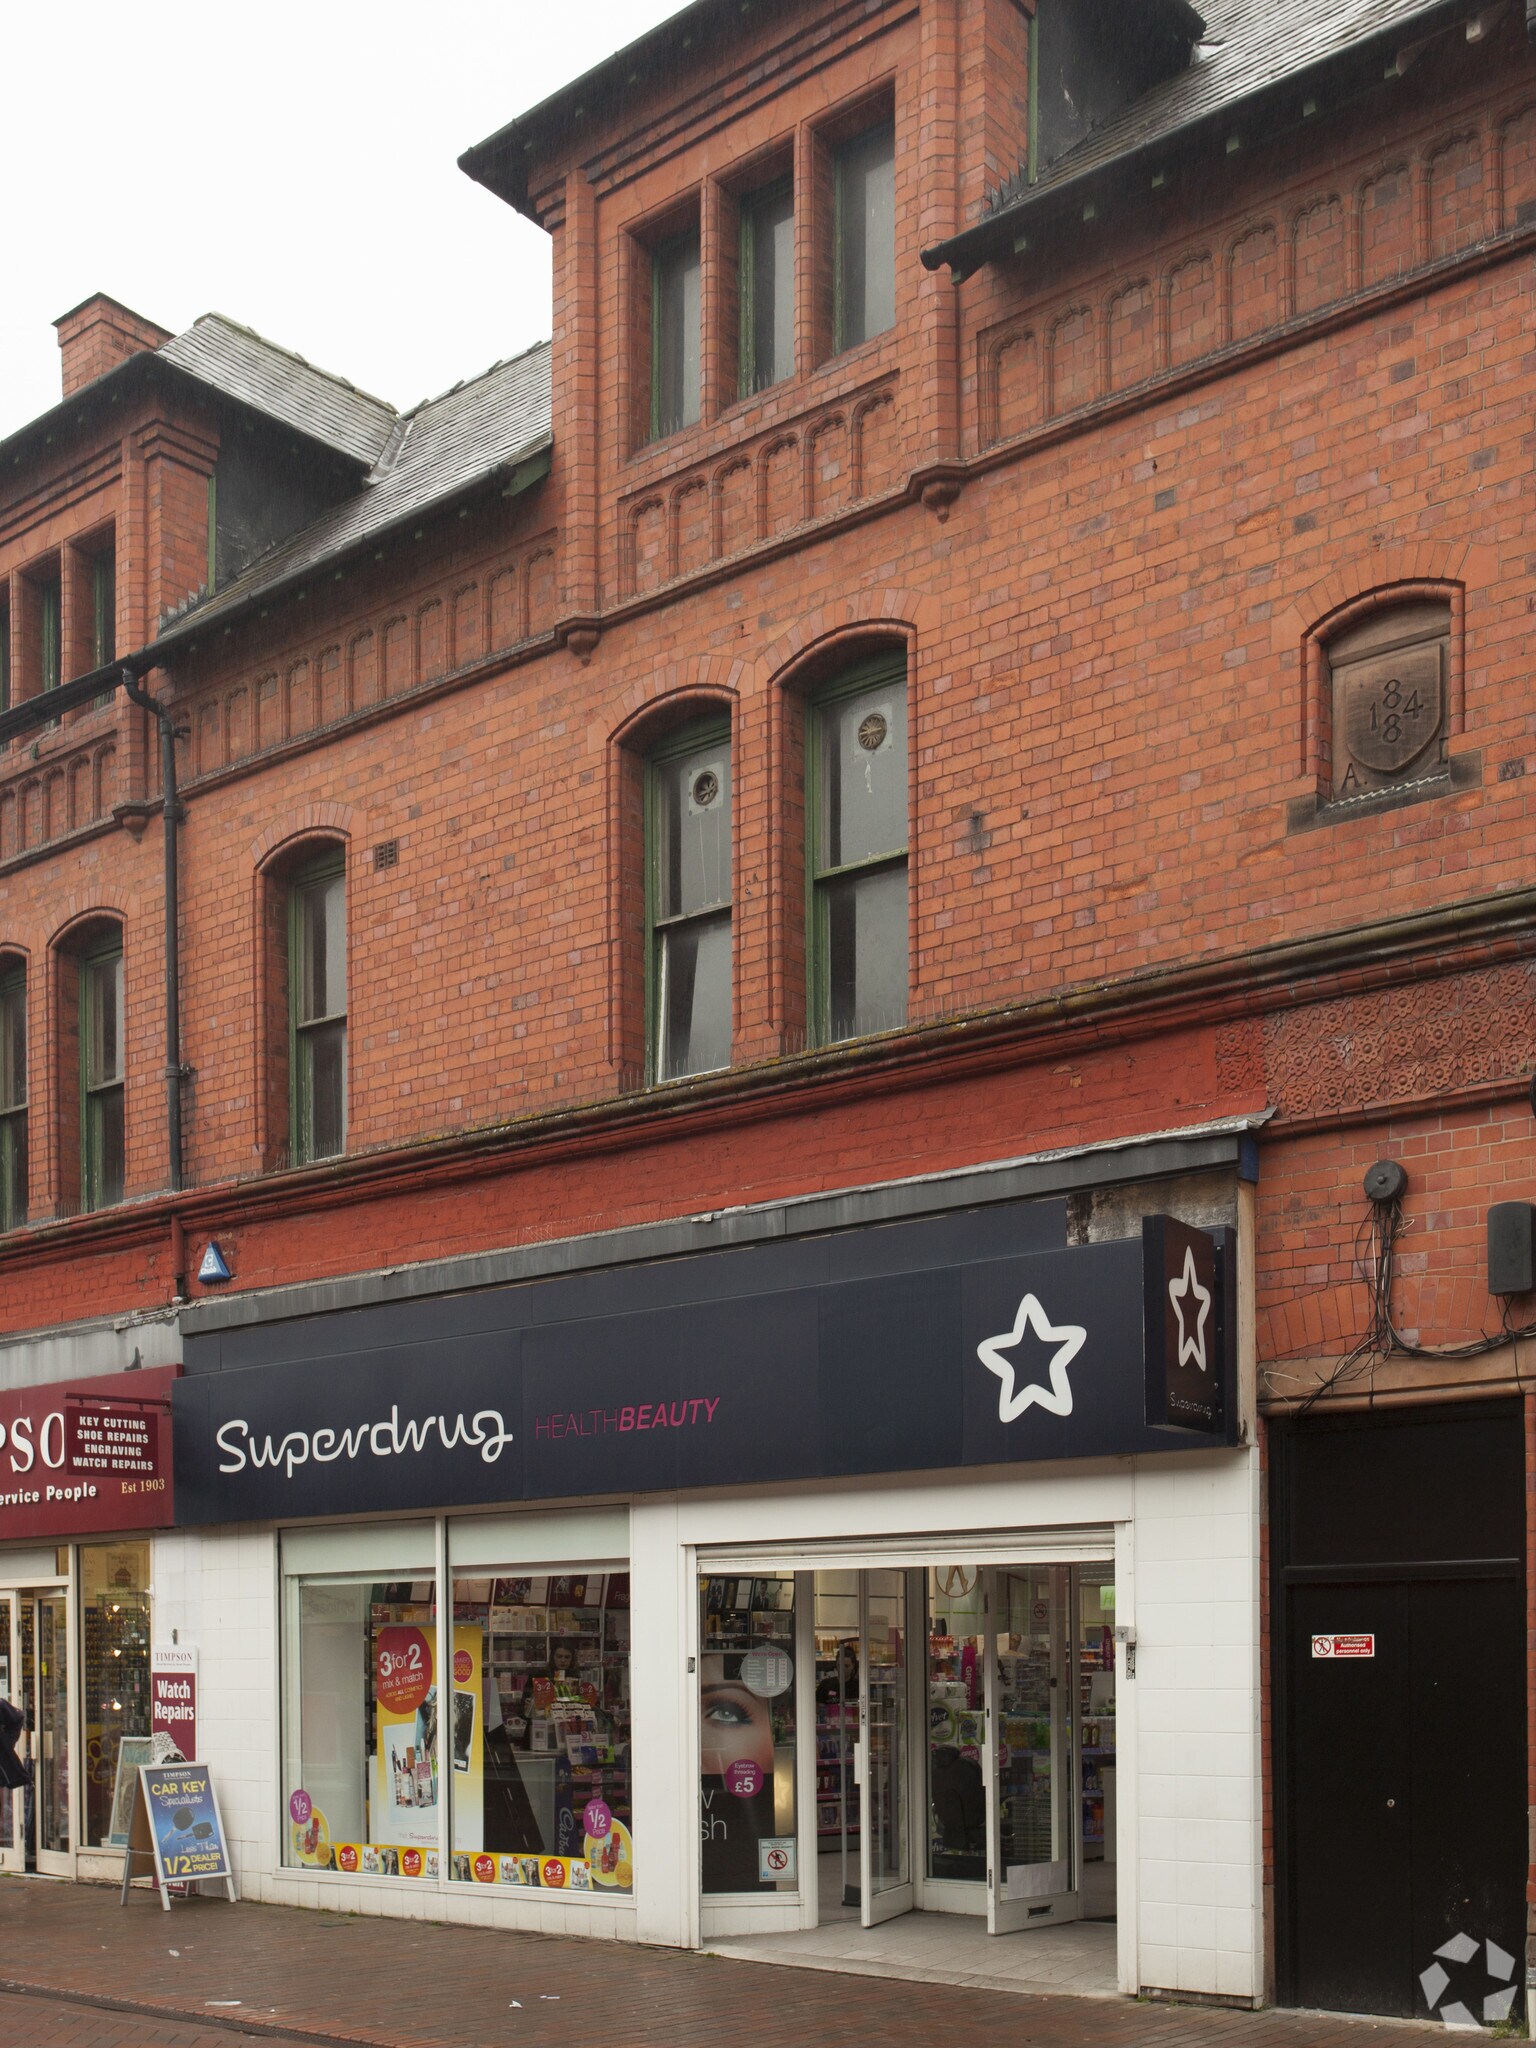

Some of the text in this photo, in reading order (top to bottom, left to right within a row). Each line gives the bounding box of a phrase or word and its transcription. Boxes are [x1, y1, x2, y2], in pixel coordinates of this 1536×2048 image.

[79, 1416, 146, 1430] KEY CUTTING
[77, 1430, 149, 1444] SHOE REPAIRS
[216, 1405, 513, 1478] Superdrug
[84, 1443, 142, 1457] ENGRAVING
[73, 1456, 153, 1471] WATCH REPAIRS
[46, 1482, 97, 1502] People
[121, 1478, 165, 1494] Est 1903
[155, 1652, 193, 1662] TIMPSON
[382, 1672, 424, 1690] mix & match
[157, 1680, 191, 1699] Watch
[154, 1701, 195, 1724] Repairs
[163, 1771, 192, 1779] TIMPSON
[152, 1780, 207, 1796] CAR KEY
[735, 1777, 755, 1793] £5
[293, 1797, 308, 1816] 1/2
[588, 1808, 606, 1829] 1/2
[164, 1852, 221, 1875] 1/2 DEALER
[192, 1862, 218, 1872] PRICE!
